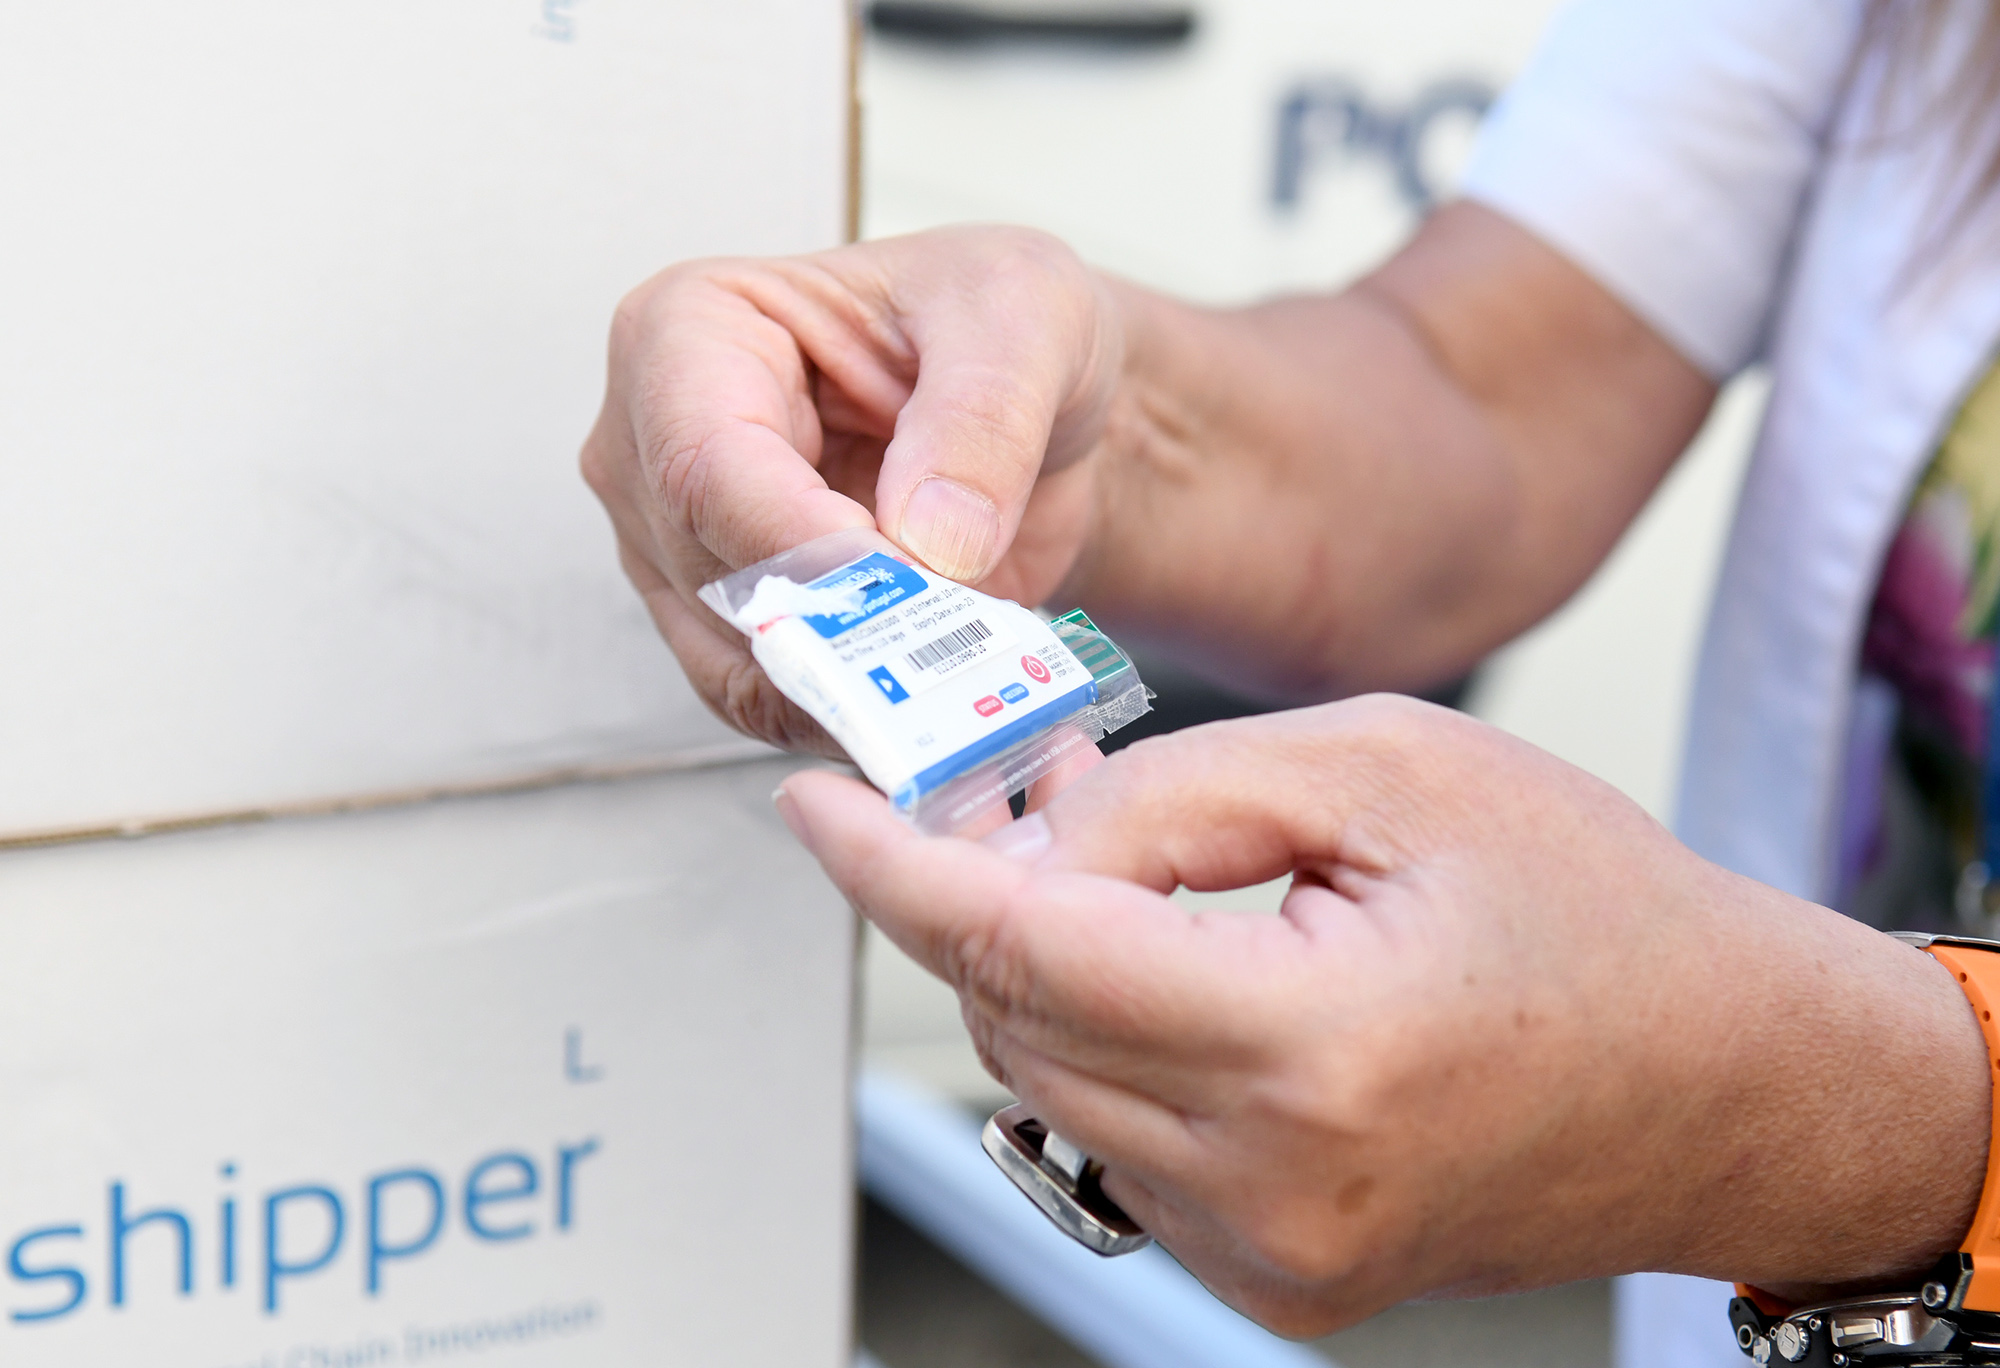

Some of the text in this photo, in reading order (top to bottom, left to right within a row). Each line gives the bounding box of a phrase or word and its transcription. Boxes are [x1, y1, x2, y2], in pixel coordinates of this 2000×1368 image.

[941, 588, 953, 599] 10
[564, 1026, 604, 1084] L
[6, 1138, 600, 1323] shipper
